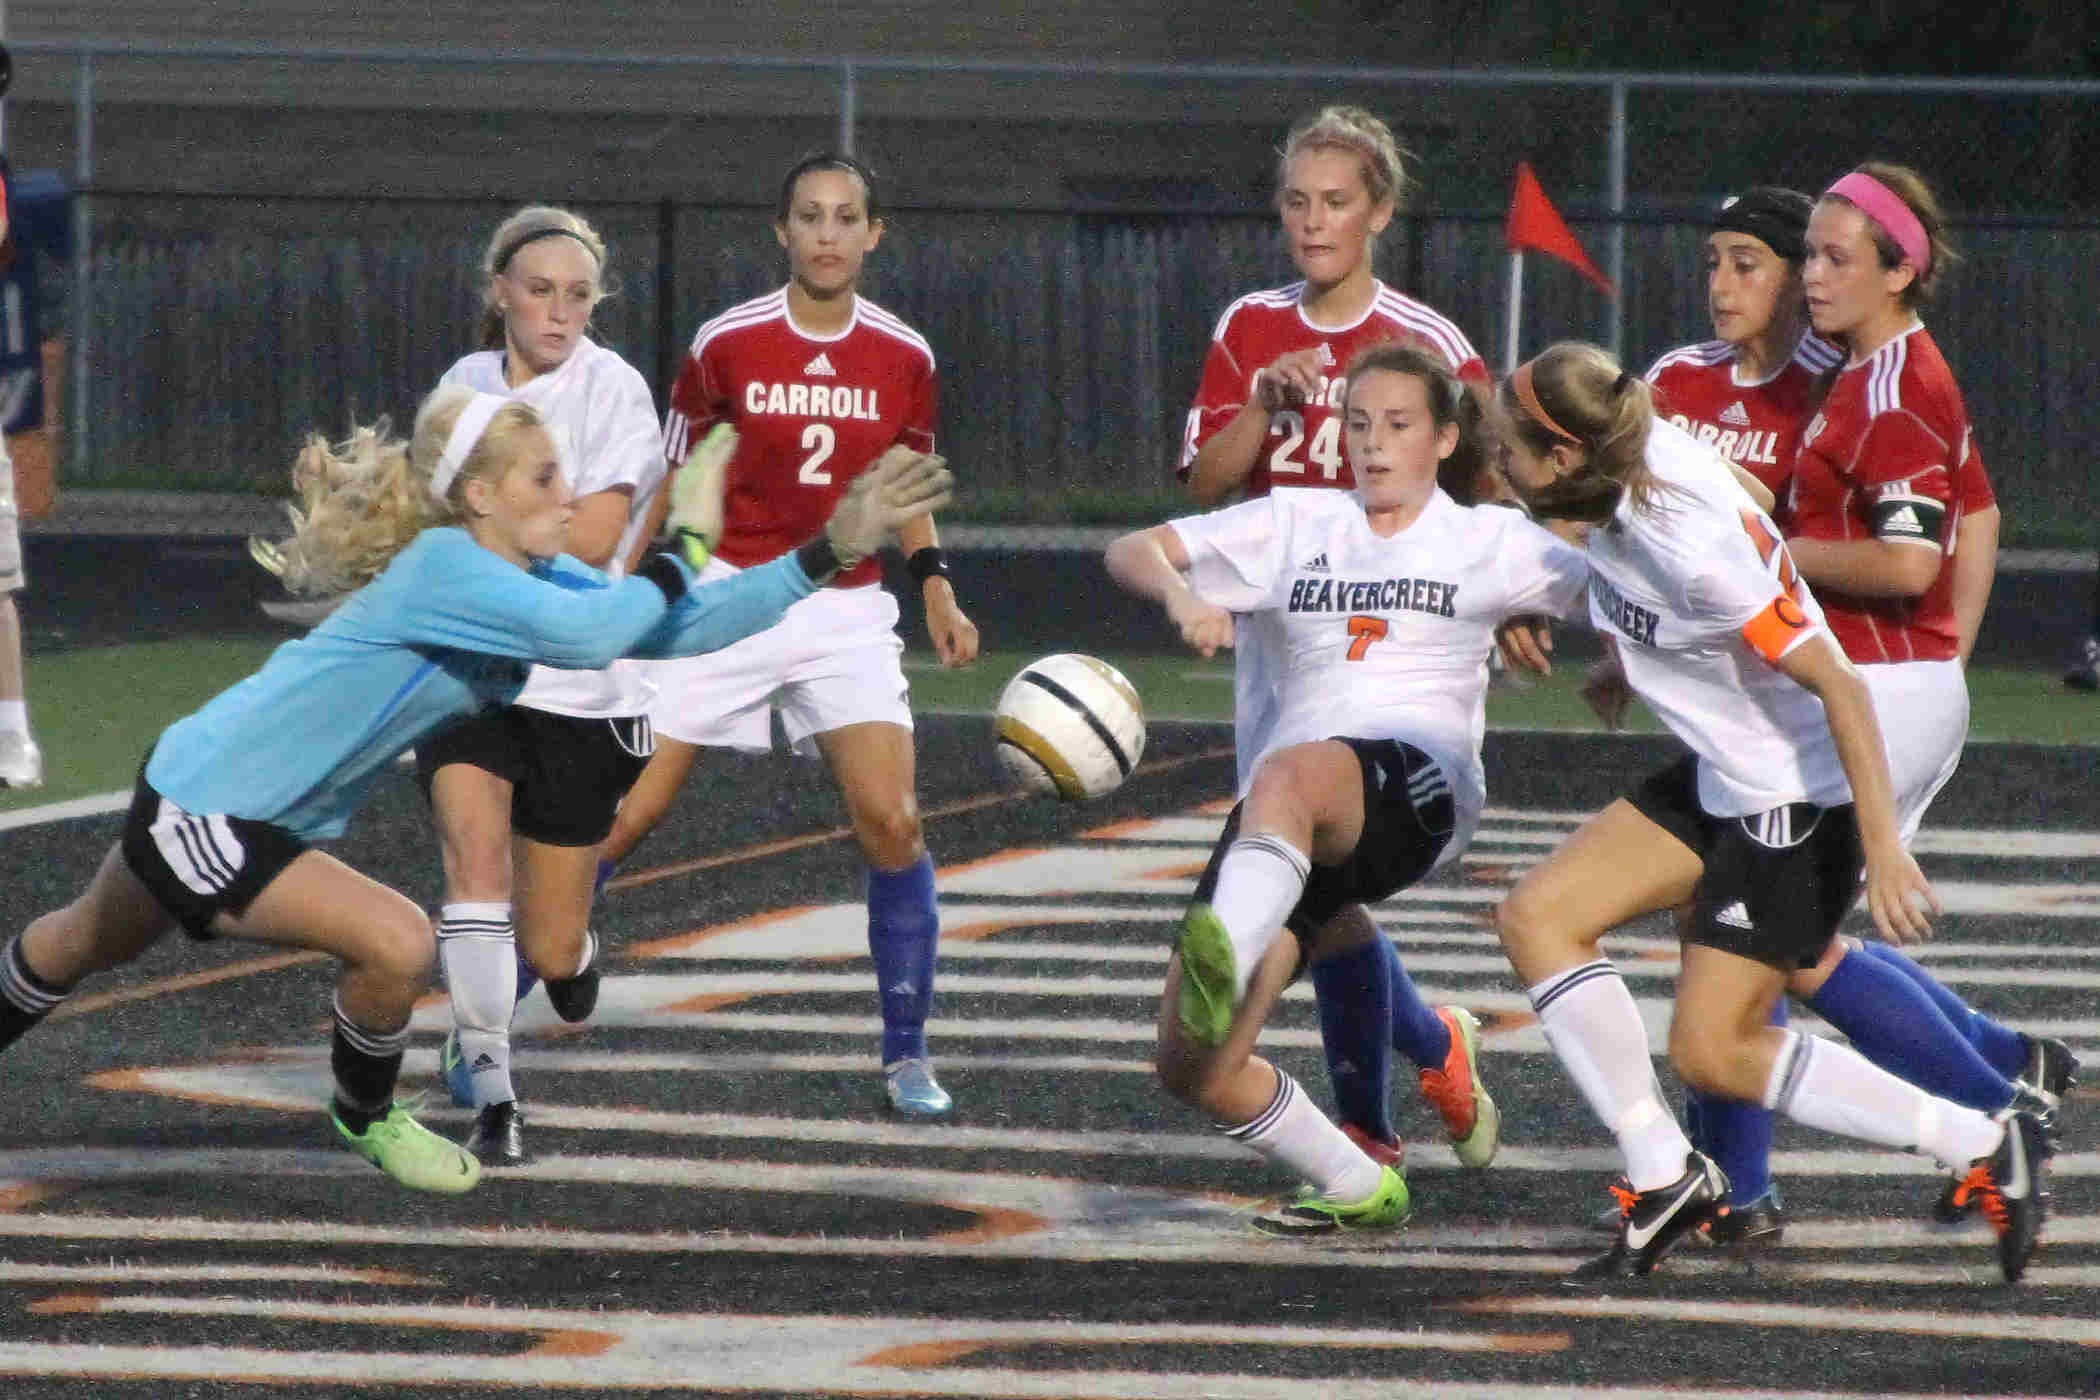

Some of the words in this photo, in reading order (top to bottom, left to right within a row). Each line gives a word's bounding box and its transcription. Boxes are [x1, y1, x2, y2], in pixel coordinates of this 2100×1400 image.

[746, 381, 880, 420] CARROLL
[798, 423, 836, 485] 2
[1270, 409, 1343, 480] 24
[1289, 578, 1458, 618] BEAVERCREEK
[1345, 615, 1389, 662] 7
